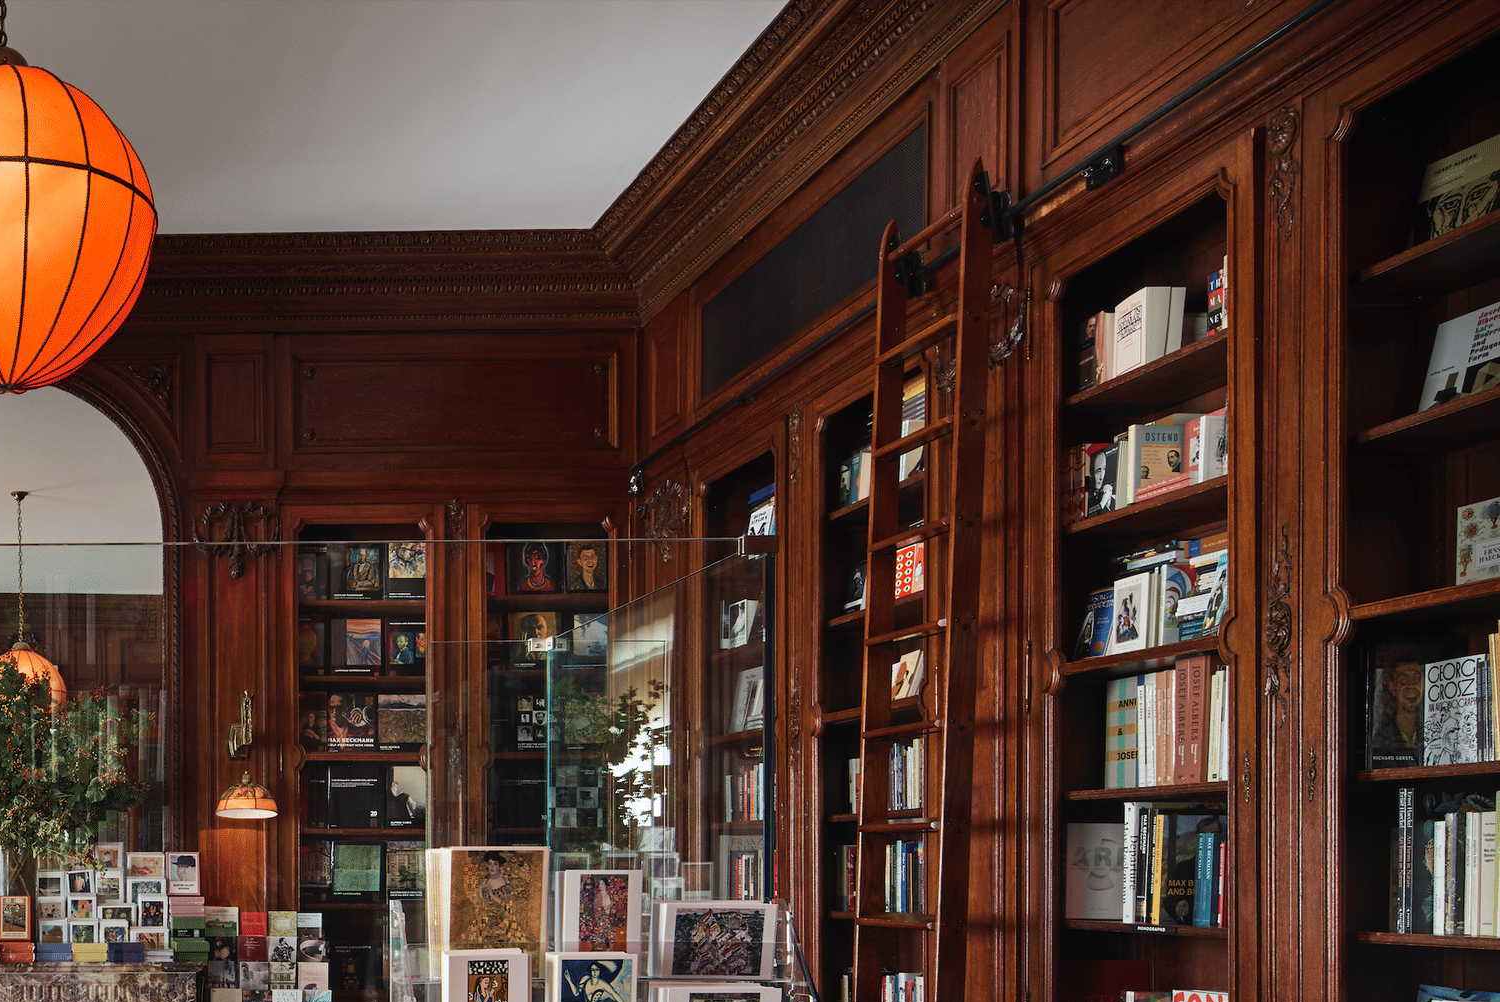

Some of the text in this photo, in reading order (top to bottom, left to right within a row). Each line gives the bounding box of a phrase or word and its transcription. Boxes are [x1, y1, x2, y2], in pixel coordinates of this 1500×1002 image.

[1467, 352, 1490, 363] Form
[1145, 431, 1179, 442] OSTEND
[1428, 678, 1475, 703] GROSZ
[1118, 697, 1137, 709] ANNI
[1177, 665, 1186, 743] JOSEF ALBERS
[1190, 664, 1200, 741] JOSEF ALBERS
[1118, 727, 1124, 736] &
[1129, 835, 1138, 891] Departure
[1168, 879, 1187, 887] MAX
[1167, 887, 1186, 895] AND
[468, 960, 508, 969] KUNST
[469, 967, 507, 975] SCHAU
